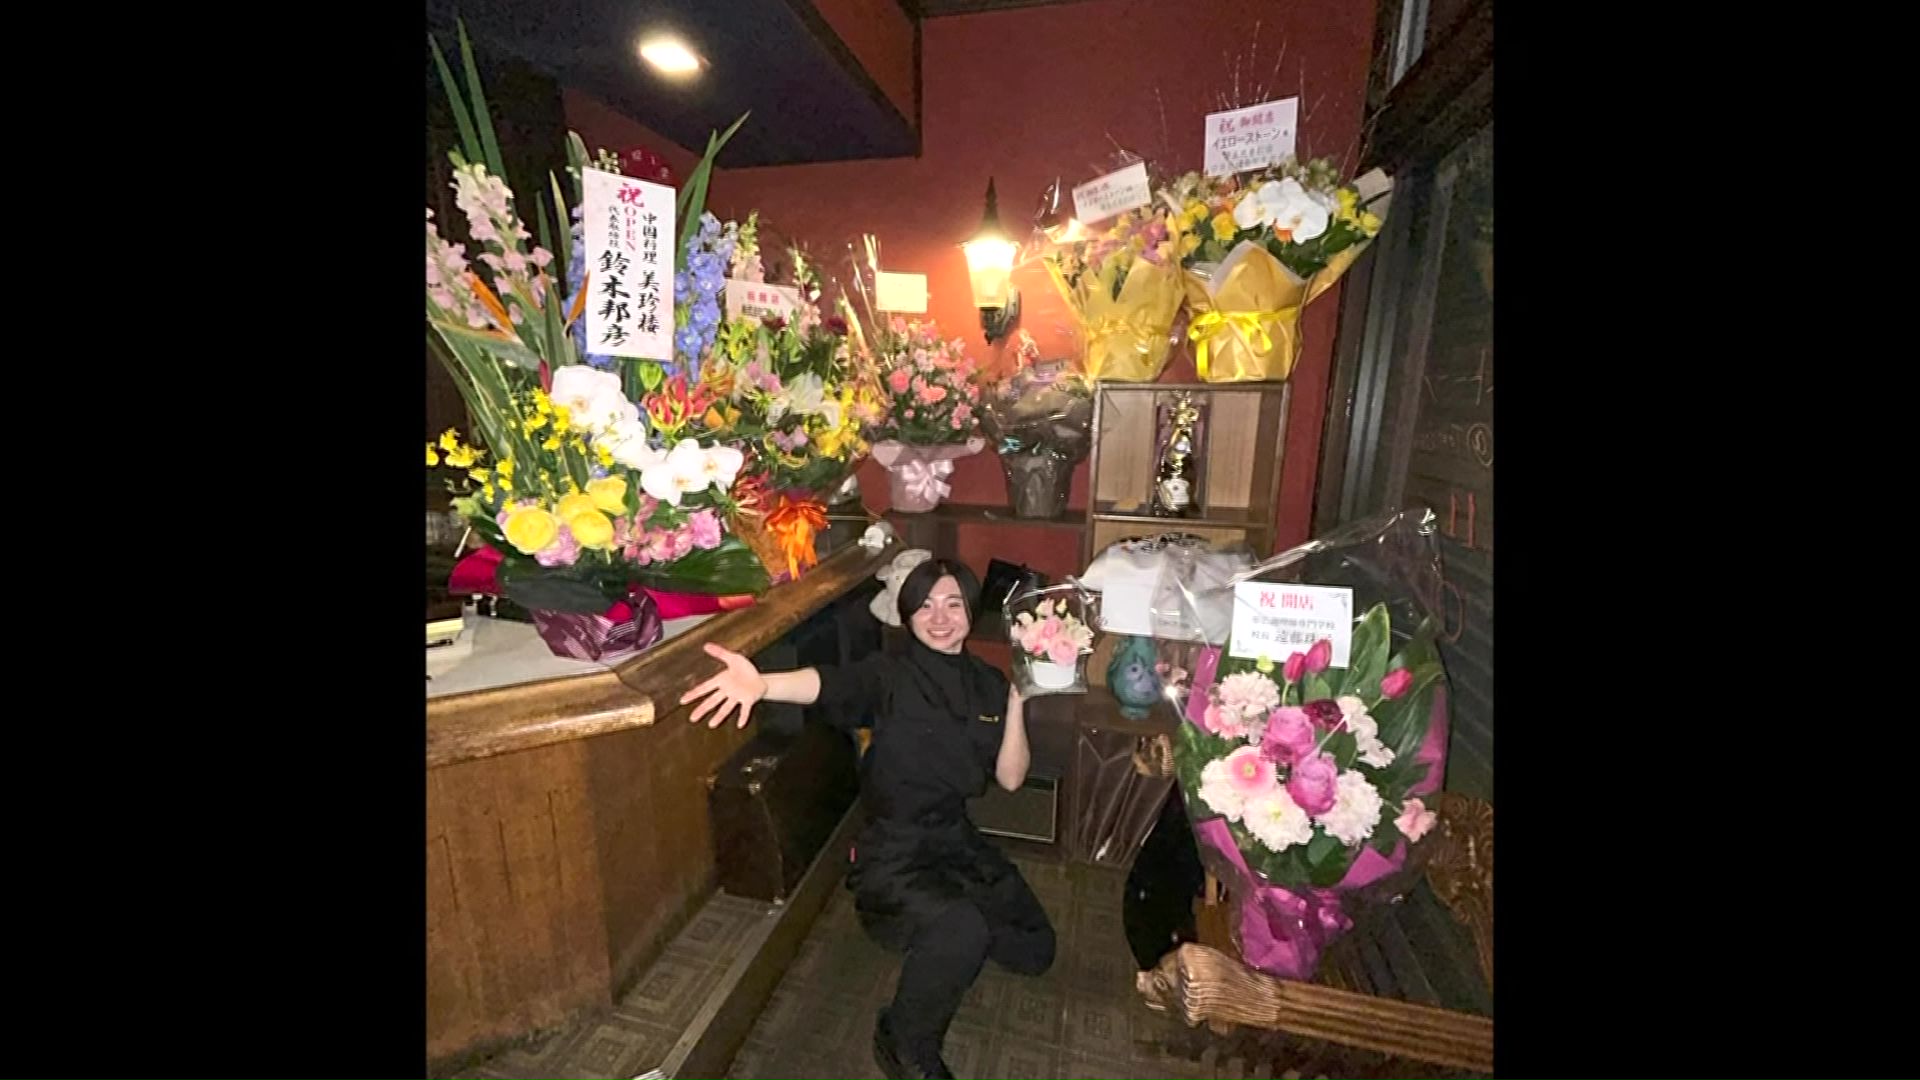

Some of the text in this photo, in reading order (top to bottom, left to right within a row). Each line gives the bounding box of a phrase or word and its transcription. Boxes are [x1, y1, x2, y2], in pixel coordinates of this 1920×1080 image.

[1219, 118, 1235, 134] 祝
[617, 182, 645, 208] 祝
[624, 206, 638, 251] OPEN
[642, 212, 658, 265] 中国料理
[597, 249, 631, 348] 鈴木邦彦
[1260, 591, 1314, 611] 祝 開店
